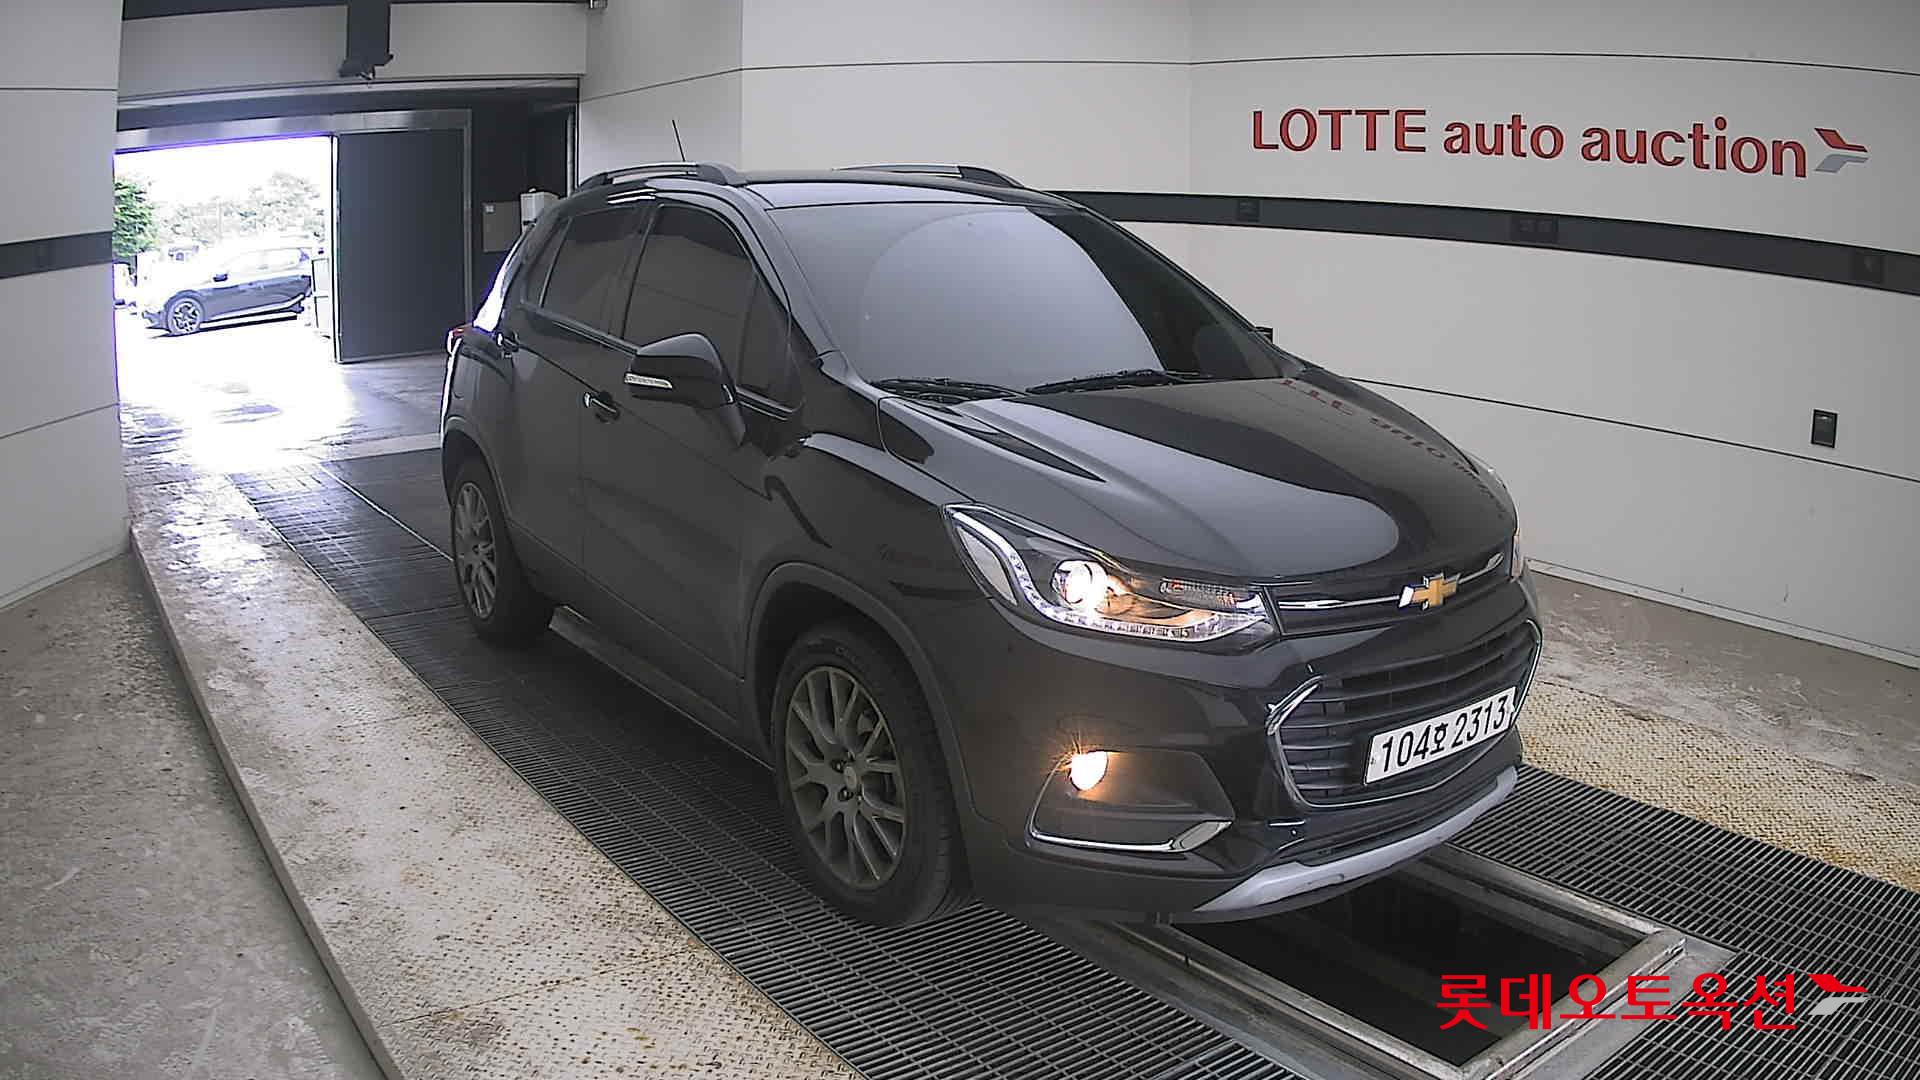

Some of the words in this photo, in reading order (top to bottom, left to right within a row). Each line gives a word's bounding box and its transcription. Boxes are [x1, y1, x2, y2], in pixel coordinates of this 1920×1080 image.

[1252, 108, 1427, 152] LOTTE
[1443, 115, 1565, 159] auto
[1581, 116, 1807, 178] auction
[1451, 695, 1509, 748] 2313
